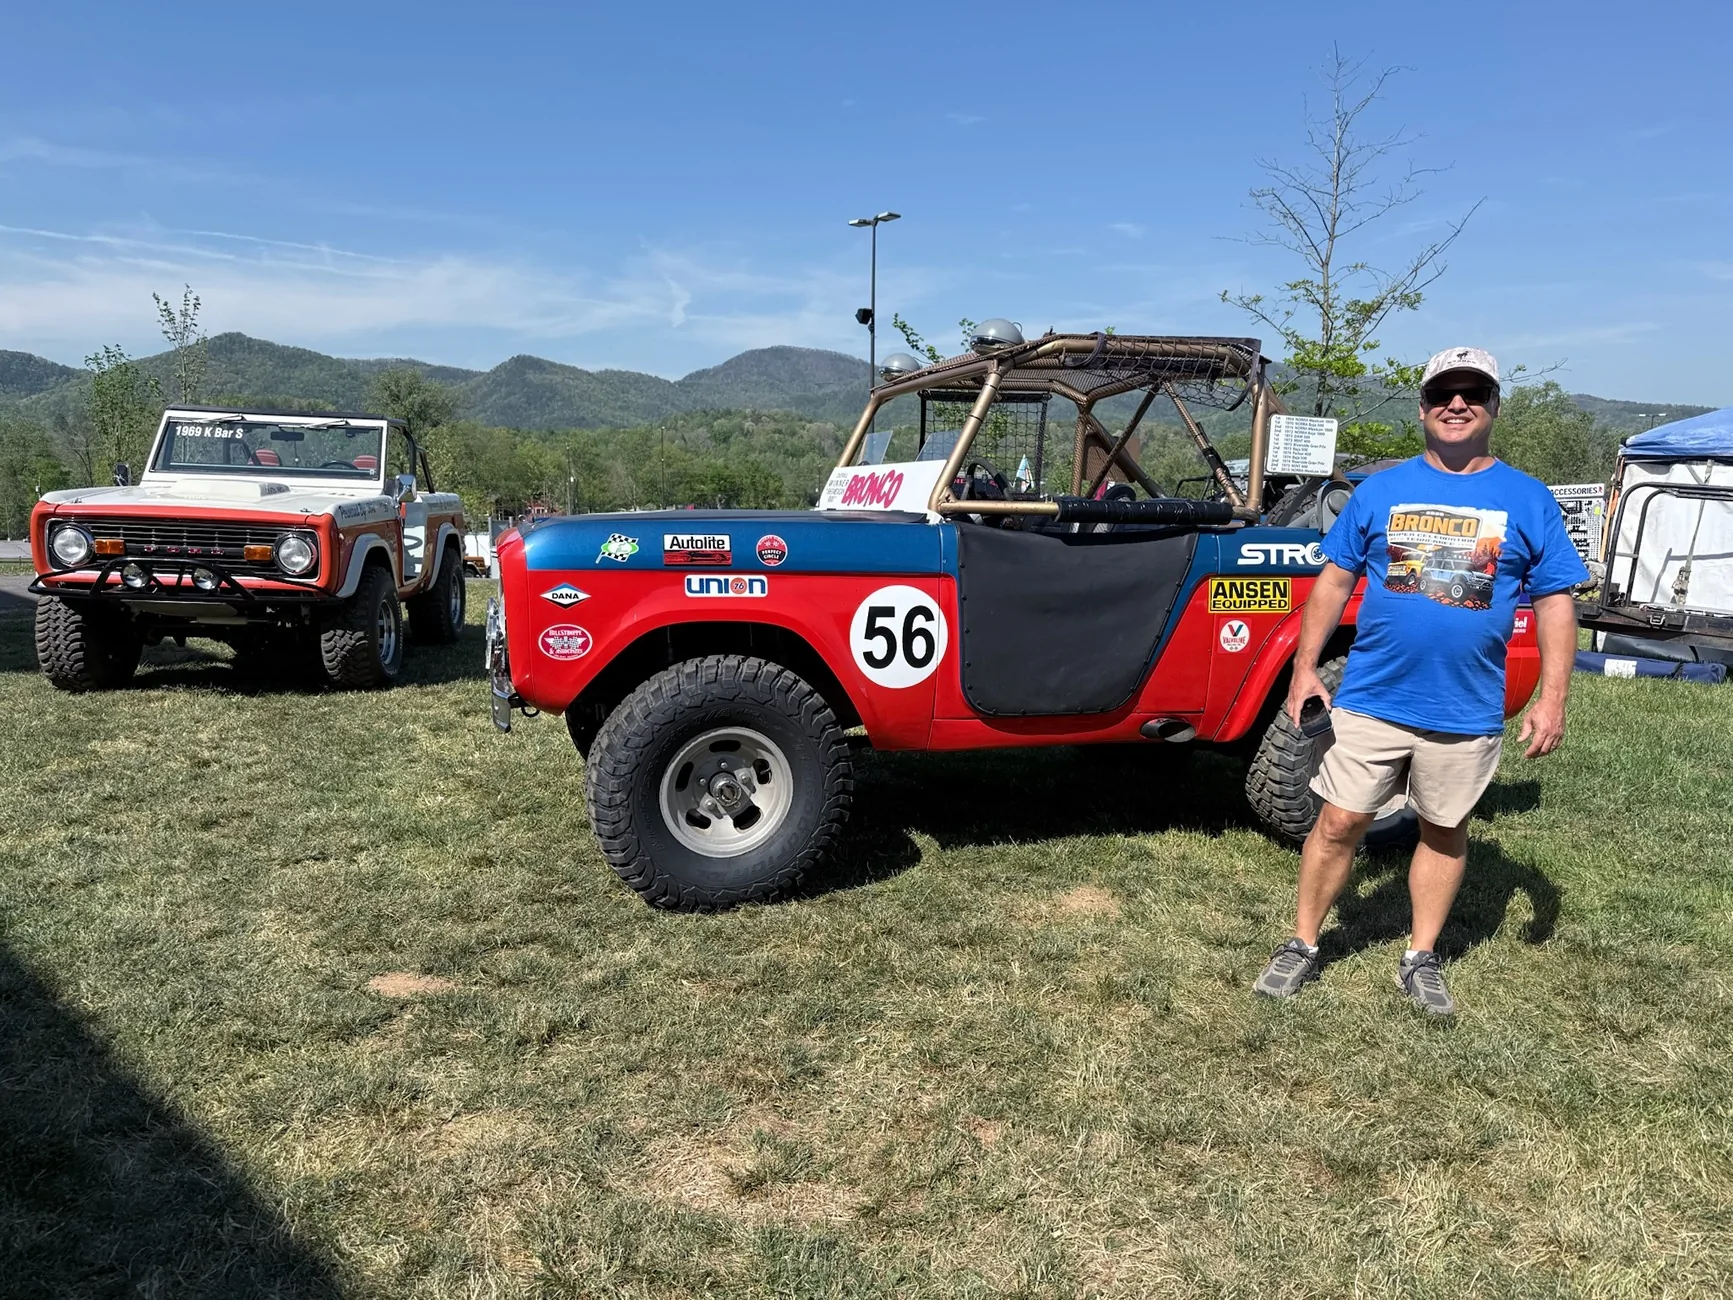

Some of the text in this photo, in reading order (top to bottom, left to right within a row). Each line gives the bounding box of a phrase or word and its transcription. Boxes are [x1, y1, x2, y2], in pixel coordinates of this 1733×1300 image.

[175, 425, 244, 439] 1969 K Bar S
[841, 469, 904, 509] BRONCO
[1390, 513, 1479, 537] BRONCO
[669, 536, 725, 549] Autolite
[734, 582, 744, 590] 76
[1212, 581, 1288, 599] ANSEN
[1212, 600, 1288, 609] EQUIPPED
[863, 605, 936, 669] 56
